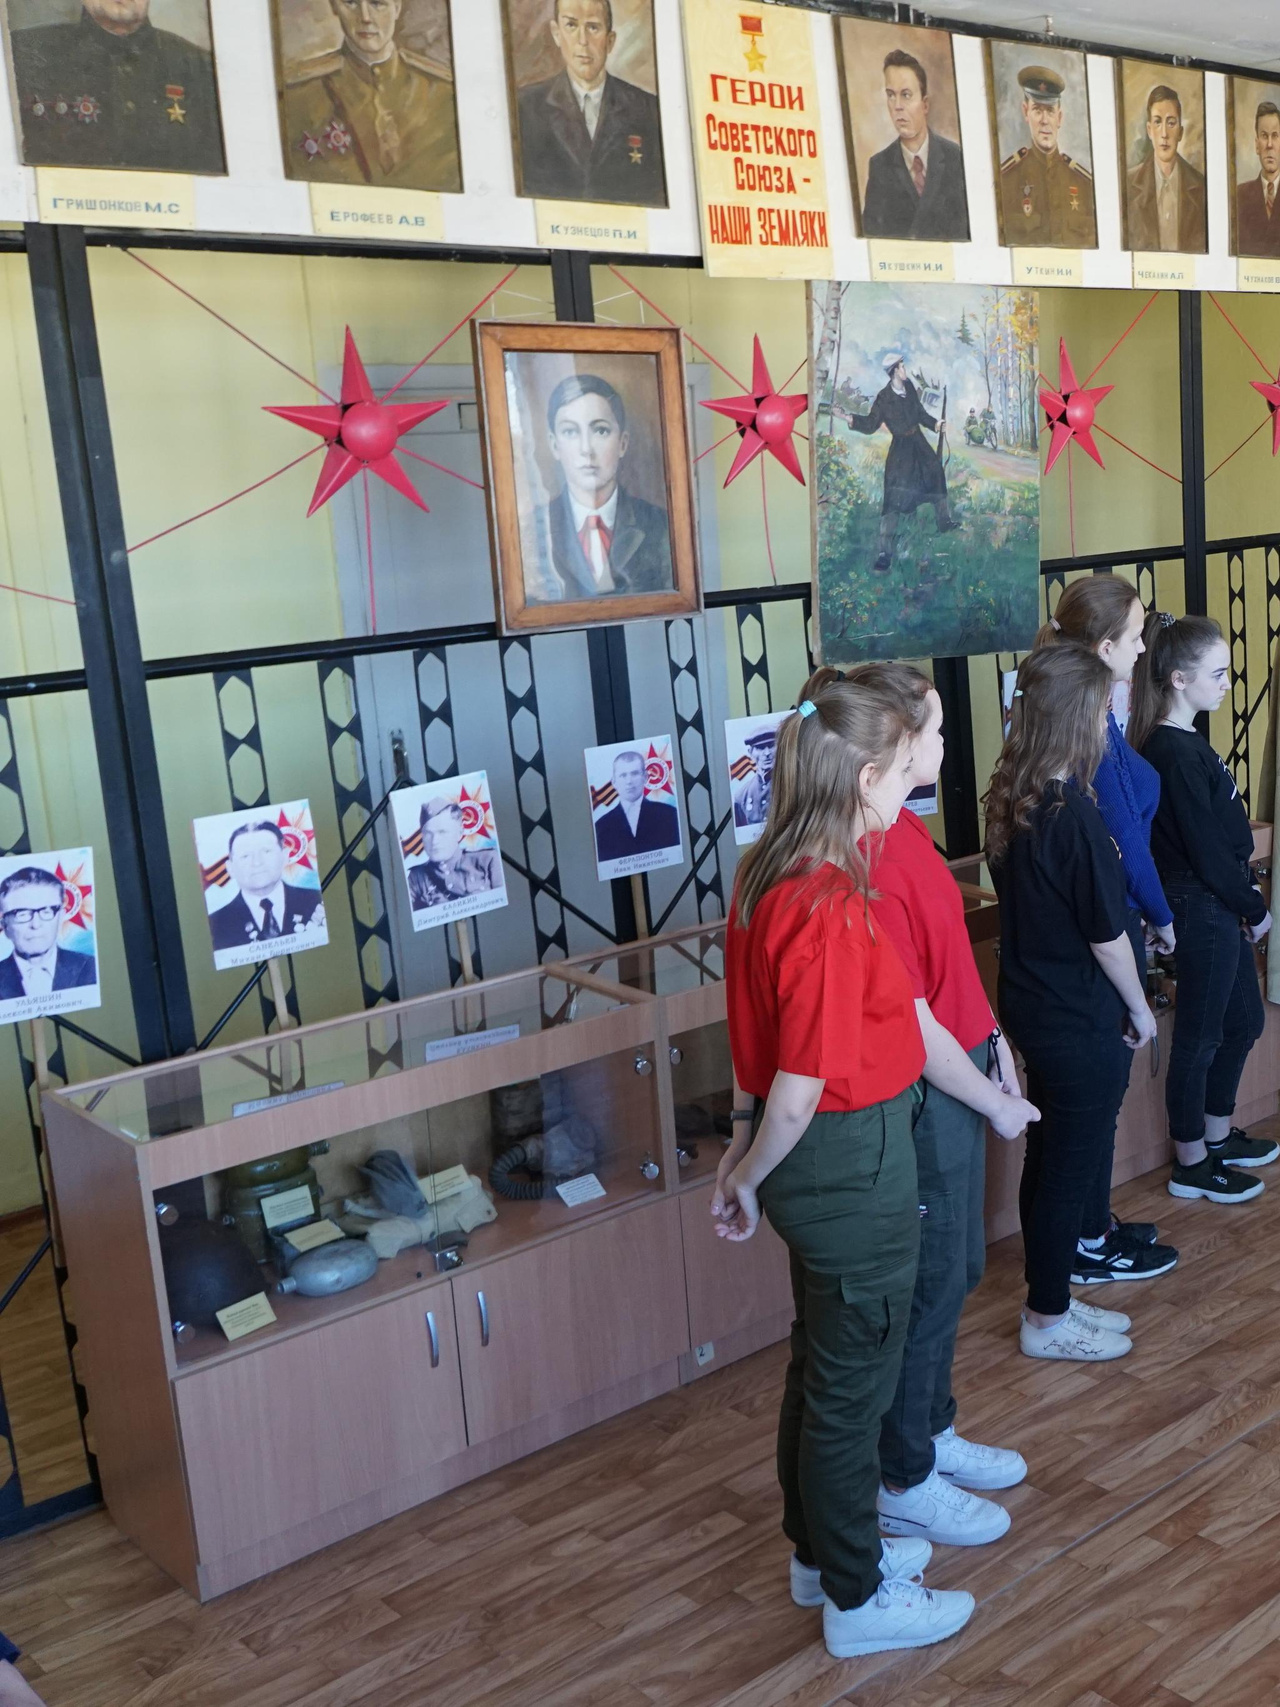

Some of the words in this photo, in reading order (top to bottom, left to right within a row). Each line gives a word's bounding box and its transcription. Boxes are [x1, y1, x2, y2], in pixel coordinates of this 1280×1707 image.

[710, 73, 805, 111] ГЕРОИ
[705, 113, 817, 159] СОВЕТСКОГО
[734, 156, 797, 194] СОЮЗА
[330, 210, 394, 225] ЕРОФЕЕВ
[550, 224, 610, 239] КУЗНЕЦОВ
[708, 204, 753, 246] НАШИ
[757, 207, 829, 248] ЗЕМЛЯКИ
[879, 262, 921, 271] ЯКУШКИН
[618, 850, 663, 865] ФЕРАПОНТОВ
[16, 992, 62, 1007] УЛЬЯШИН
[0, 1009, 33, 1019] лексей
